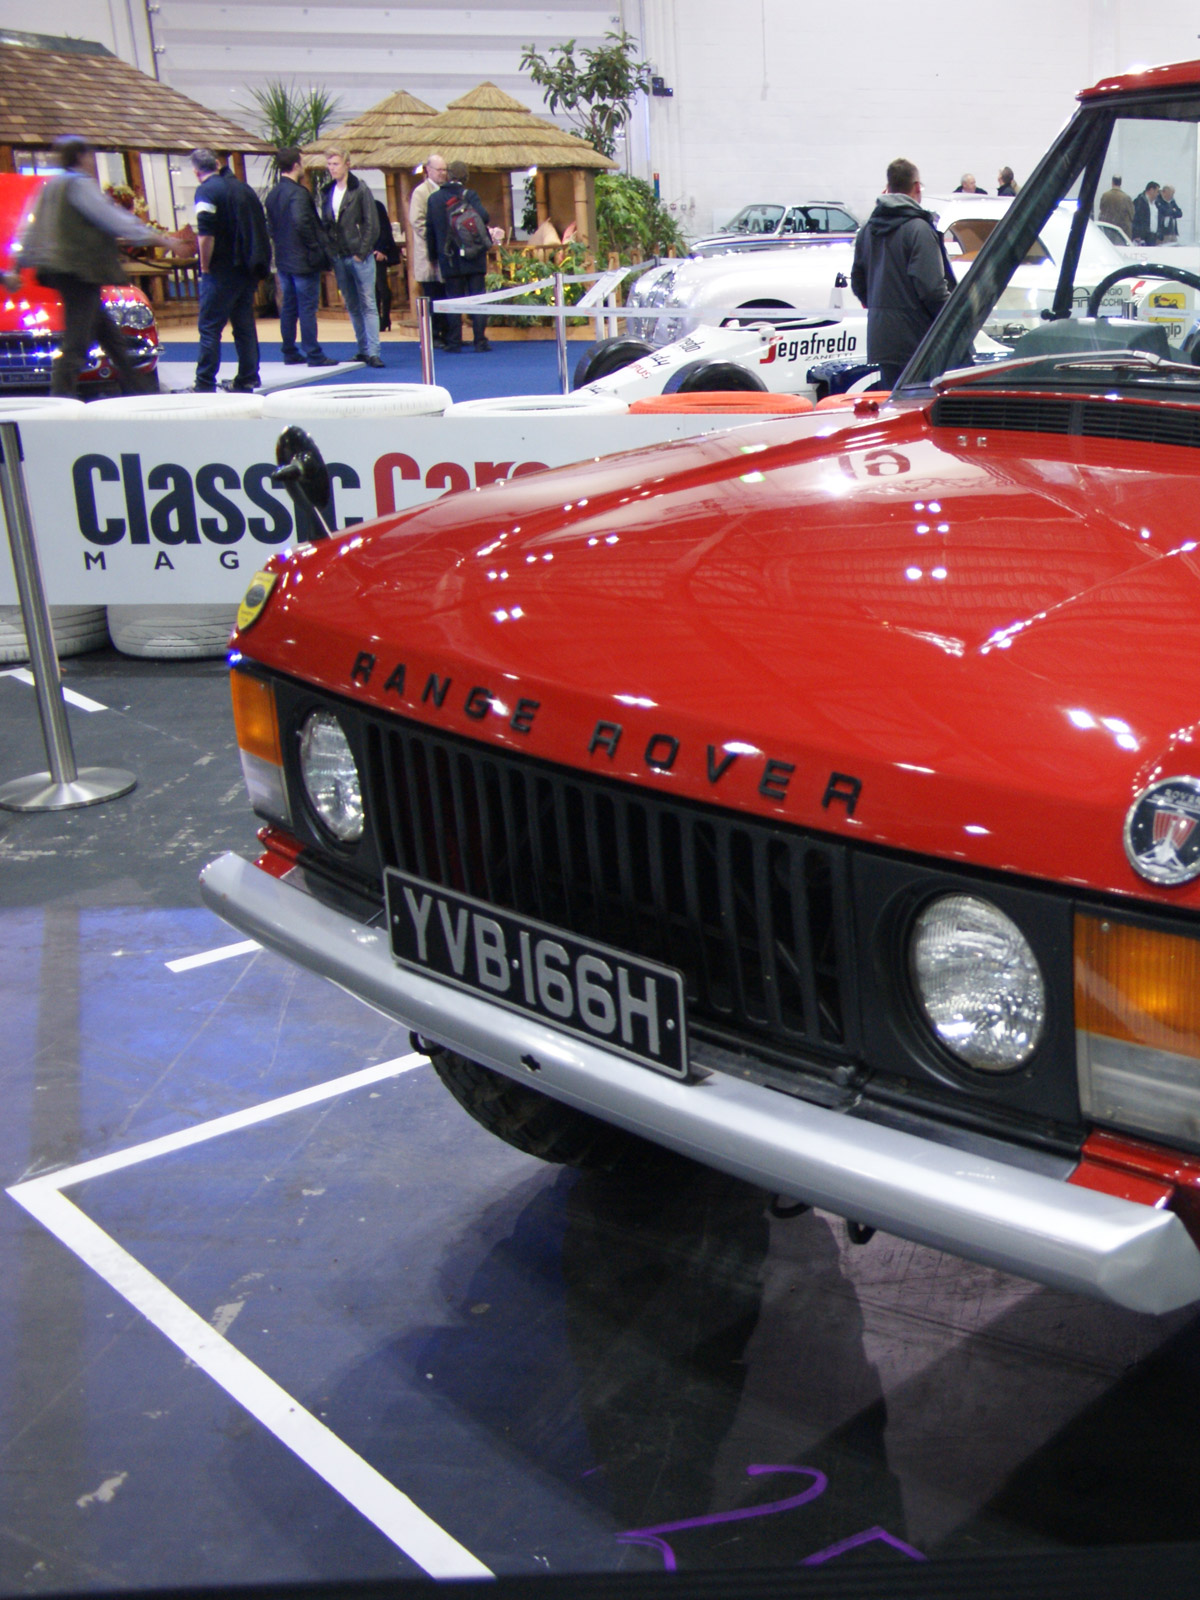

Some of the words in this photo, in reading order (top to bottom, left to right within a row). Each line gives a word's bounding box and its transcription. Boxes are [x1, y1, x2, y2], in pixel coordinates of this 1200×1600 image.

[759, 330, 857, 365] Segafredo
[71, 452, 363, 546] Classc
[350, 651, 541, 733] RANGE
[587, 720, 863, 816] ROVER
